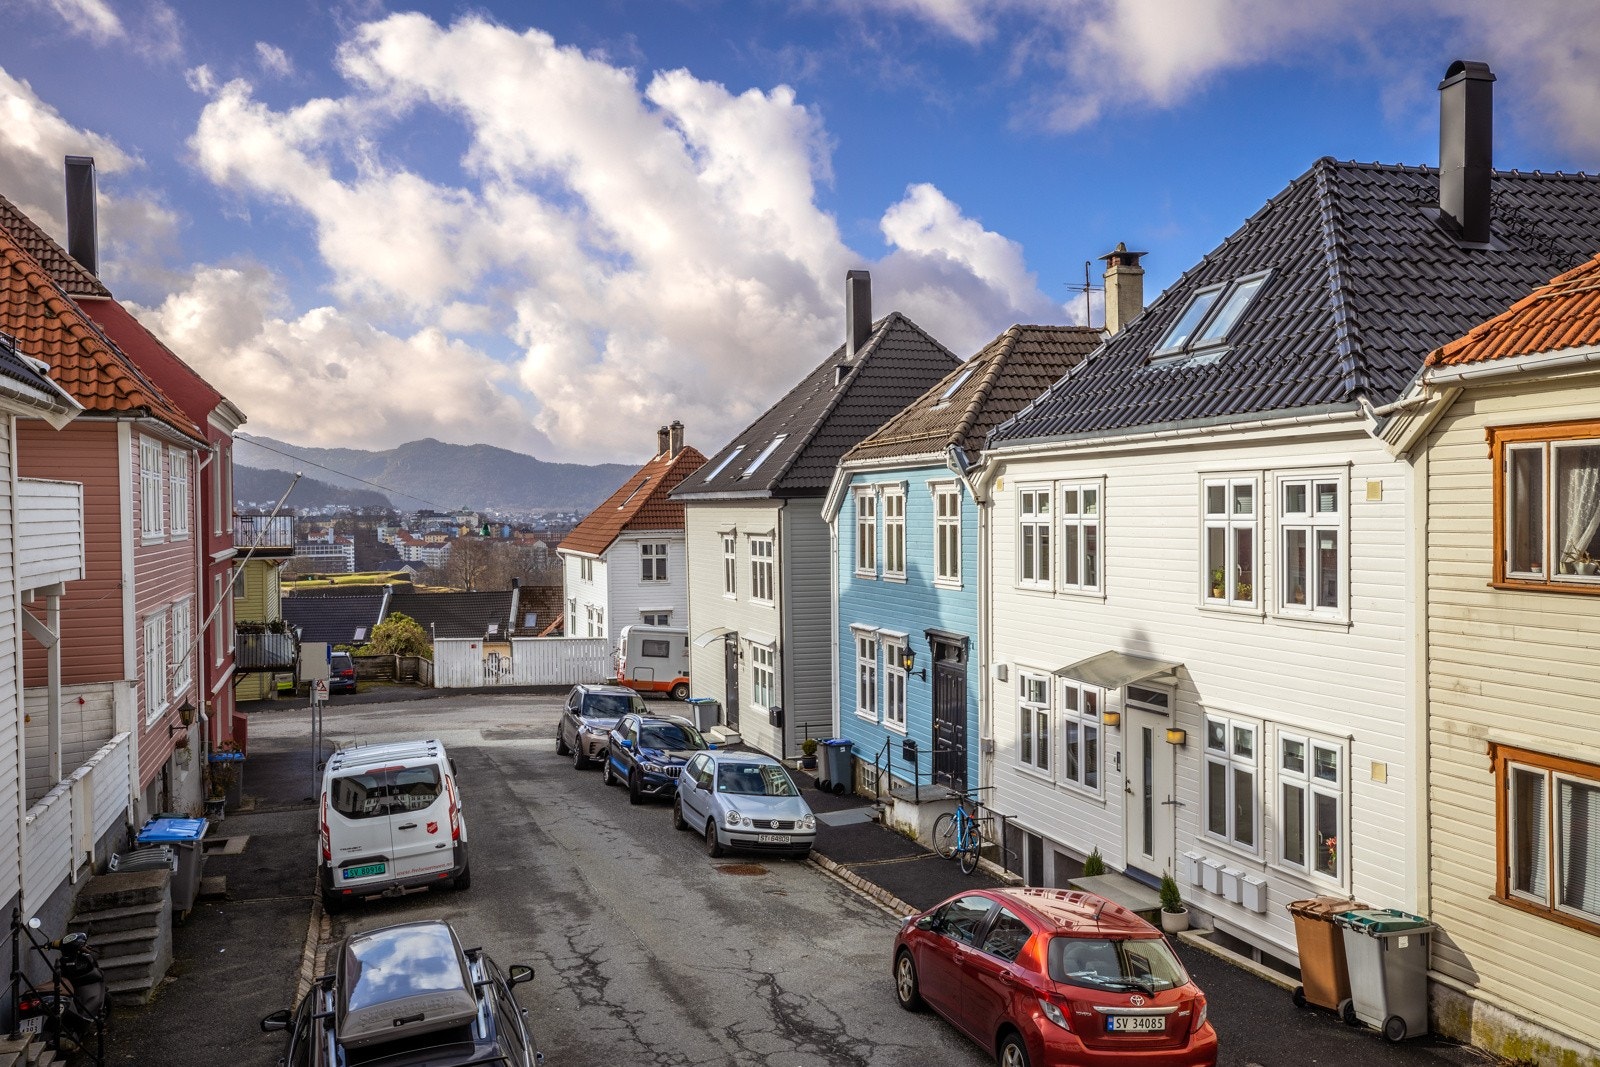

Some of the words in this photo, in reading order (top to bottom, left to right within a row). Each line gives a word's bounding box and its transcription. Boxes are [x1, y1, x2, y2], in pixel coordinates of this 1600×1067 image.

[349, 869, 359, 877] SV
[361, 865, 383, 875] 80916
[1116, 1018, 1129, 1029] SV
[1132, 1018, 1163, 1029] 34085
